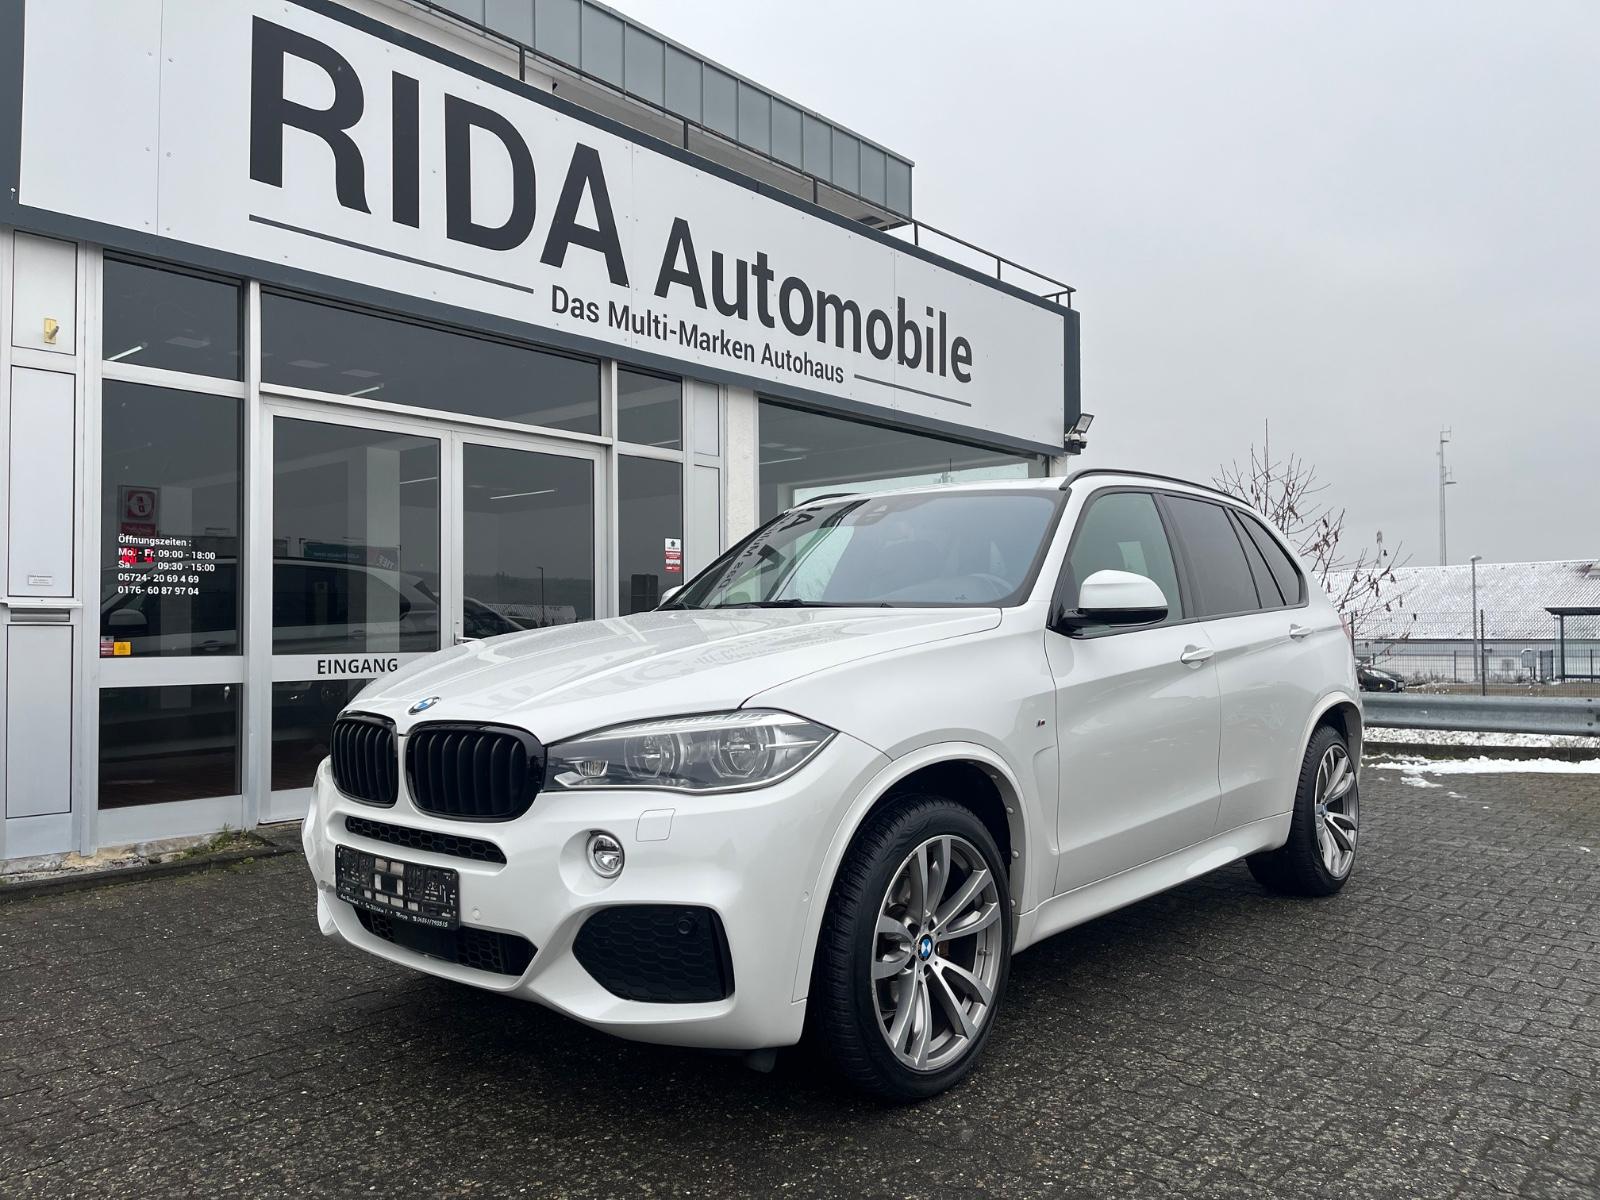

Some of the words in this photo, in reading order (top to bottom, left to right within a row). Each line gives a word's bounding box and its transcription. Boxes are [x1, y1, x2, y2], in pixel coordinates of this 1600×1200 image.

[250, 15, 629, 288] RIDA
[654, 217, 973, 383] Automobile
[552, 285, 599, 323] Das
[608, 301, 755, 363] Multi-Marken
[760, 342, 844, 383] Autohaus
[118, 533, 187, 547] Öffnungszeiten
[118, 548, 136, 557] Mo.
[158, 549, 183, 559] 09:00
[192, 551, 216, 560] 18:00
[118, 560, 133, 569] Sa.
[157, 562, 183, 571] 09:30
[191, 563, 215, 572] 15:00
[153, 574, 165, 583] 20
[167, 574, 178, 583] 69
[180, 575, 186, 583] 4
[188, 575, 199, 583] 69
[147, 586, 159, 595] 60
[161, 586, 173, 595] 87
[175, 587, 186, 595] 97
[188, 587, 199, 595] 04
[317, 658, 398, 675] EINGANG
